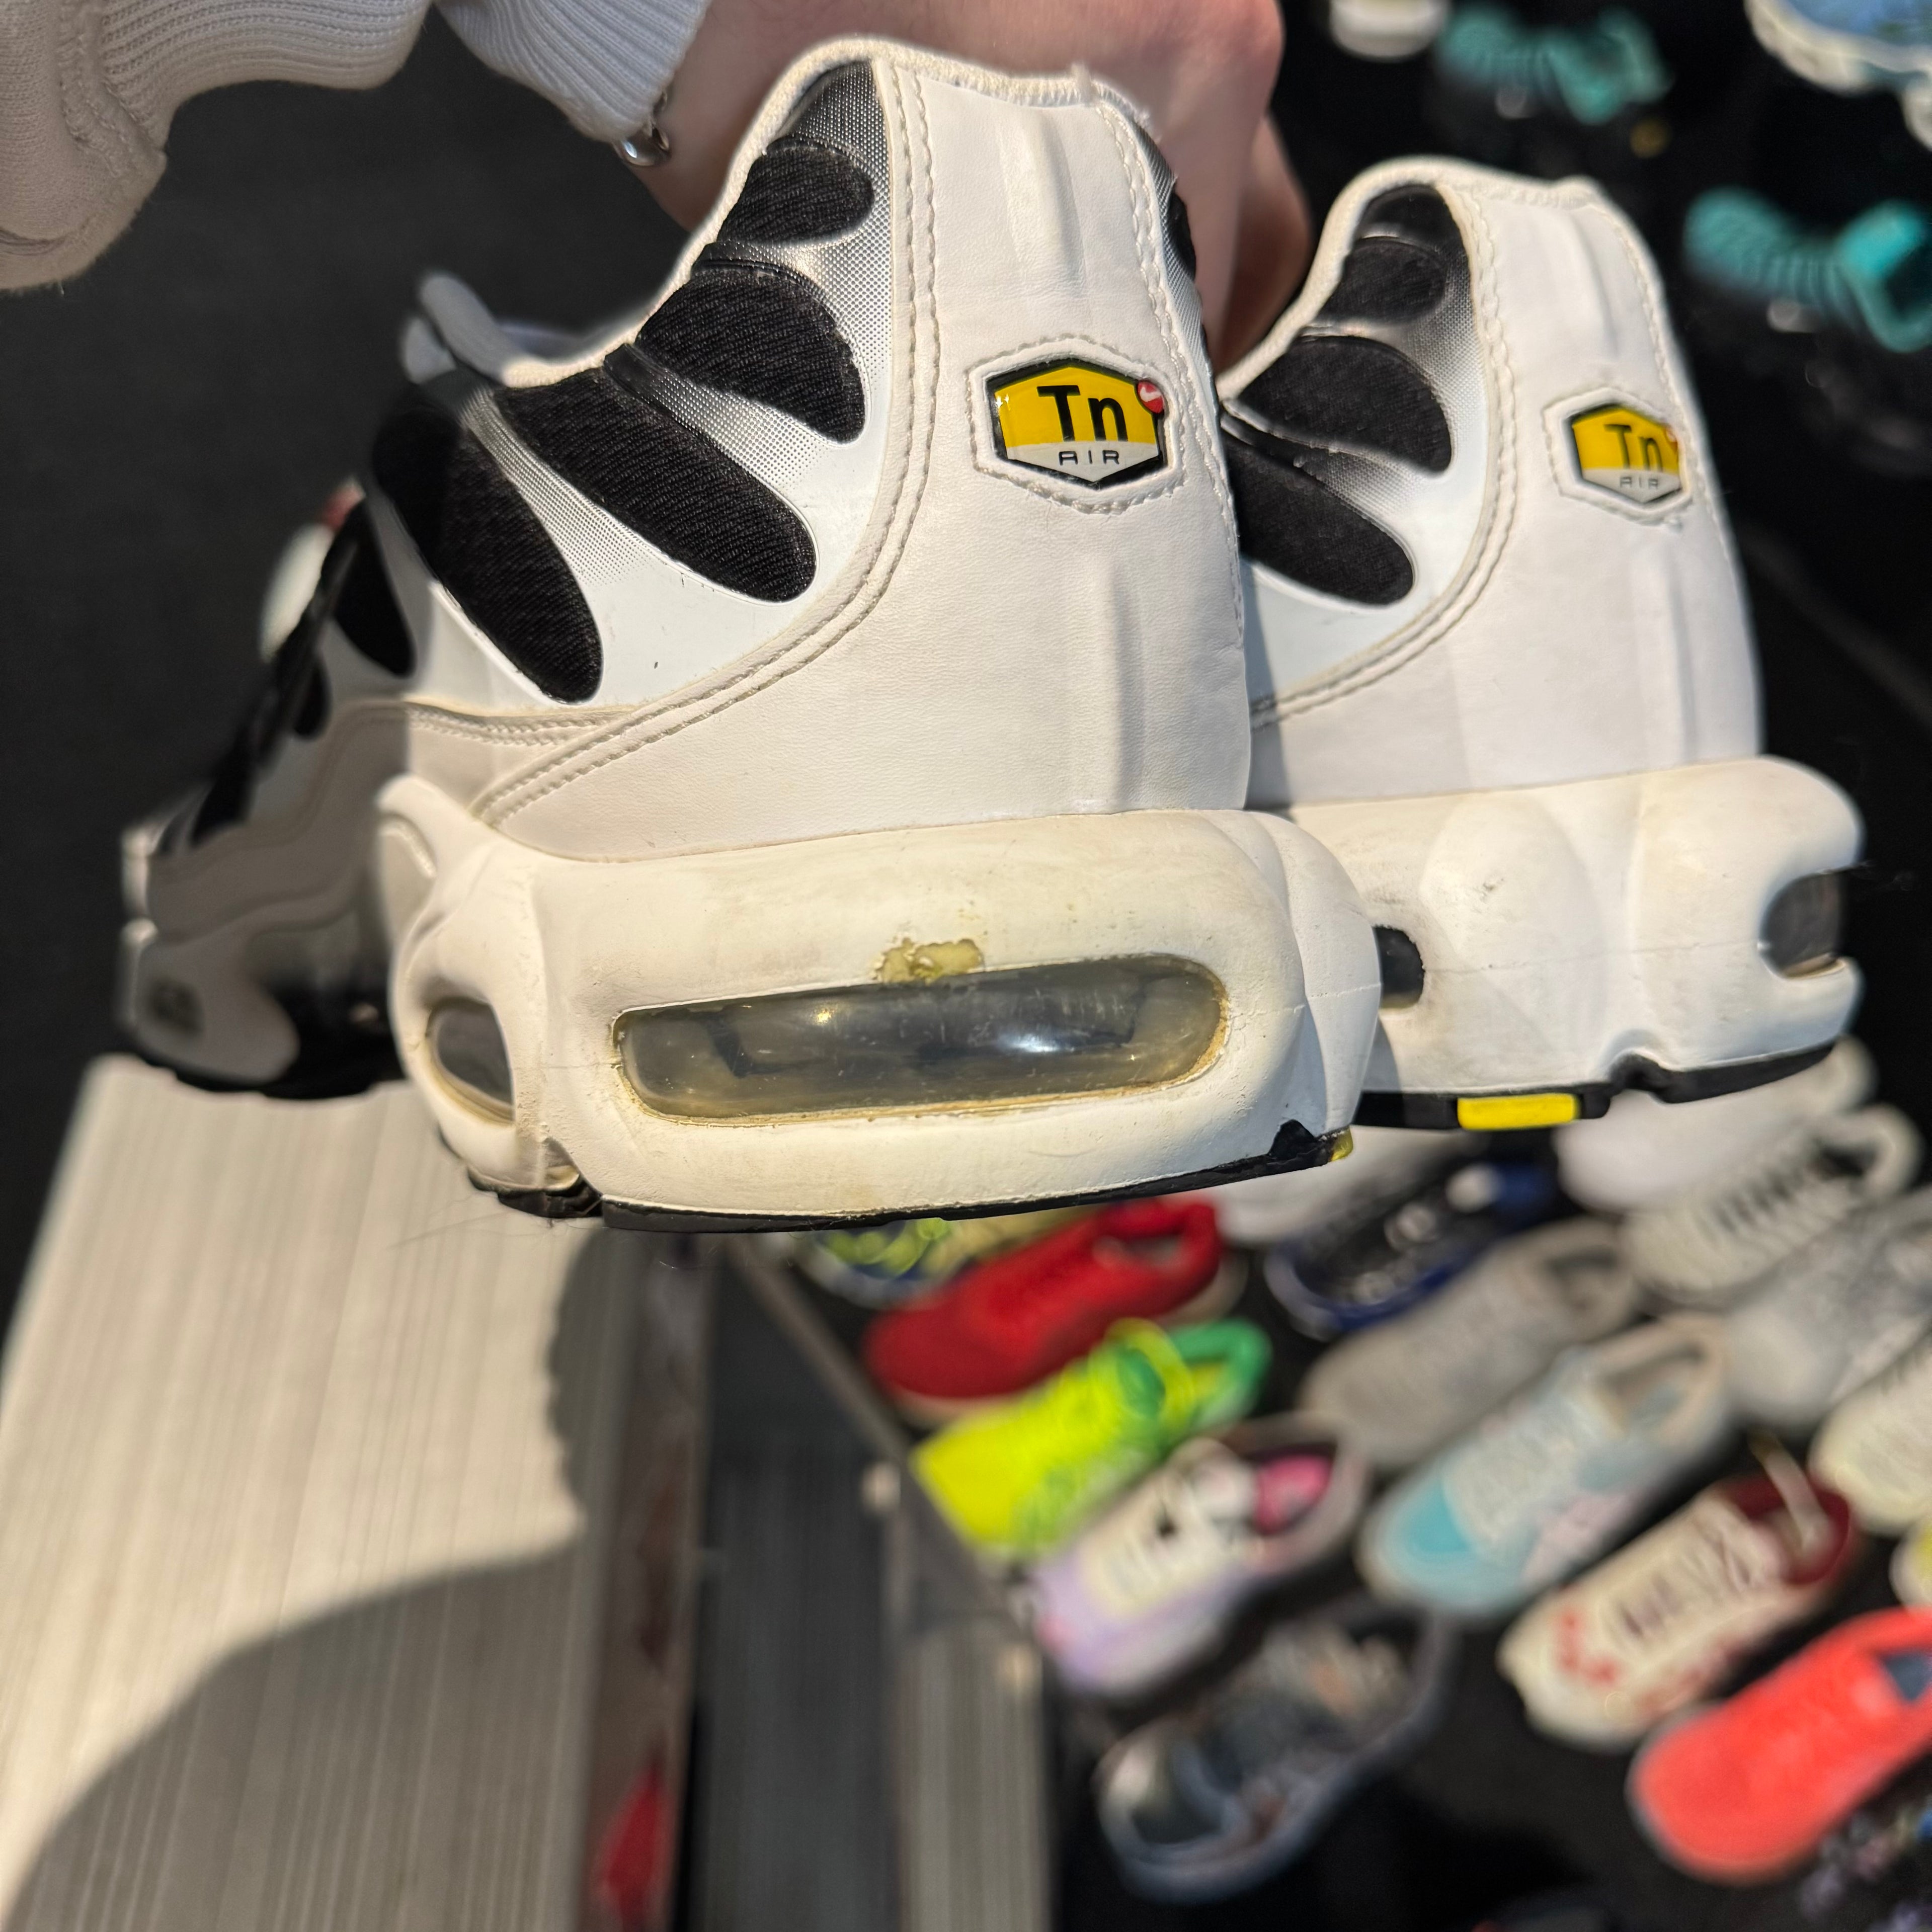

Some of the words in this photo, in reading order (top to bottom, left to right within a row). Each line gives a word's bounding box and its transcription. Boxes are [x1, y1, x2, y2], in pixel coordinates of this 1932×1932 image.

[1037, 385, 1128, 442] Tn
[1059, 450, 1119, 465] AIR
[1603, 424, 1663, 472] Tn
